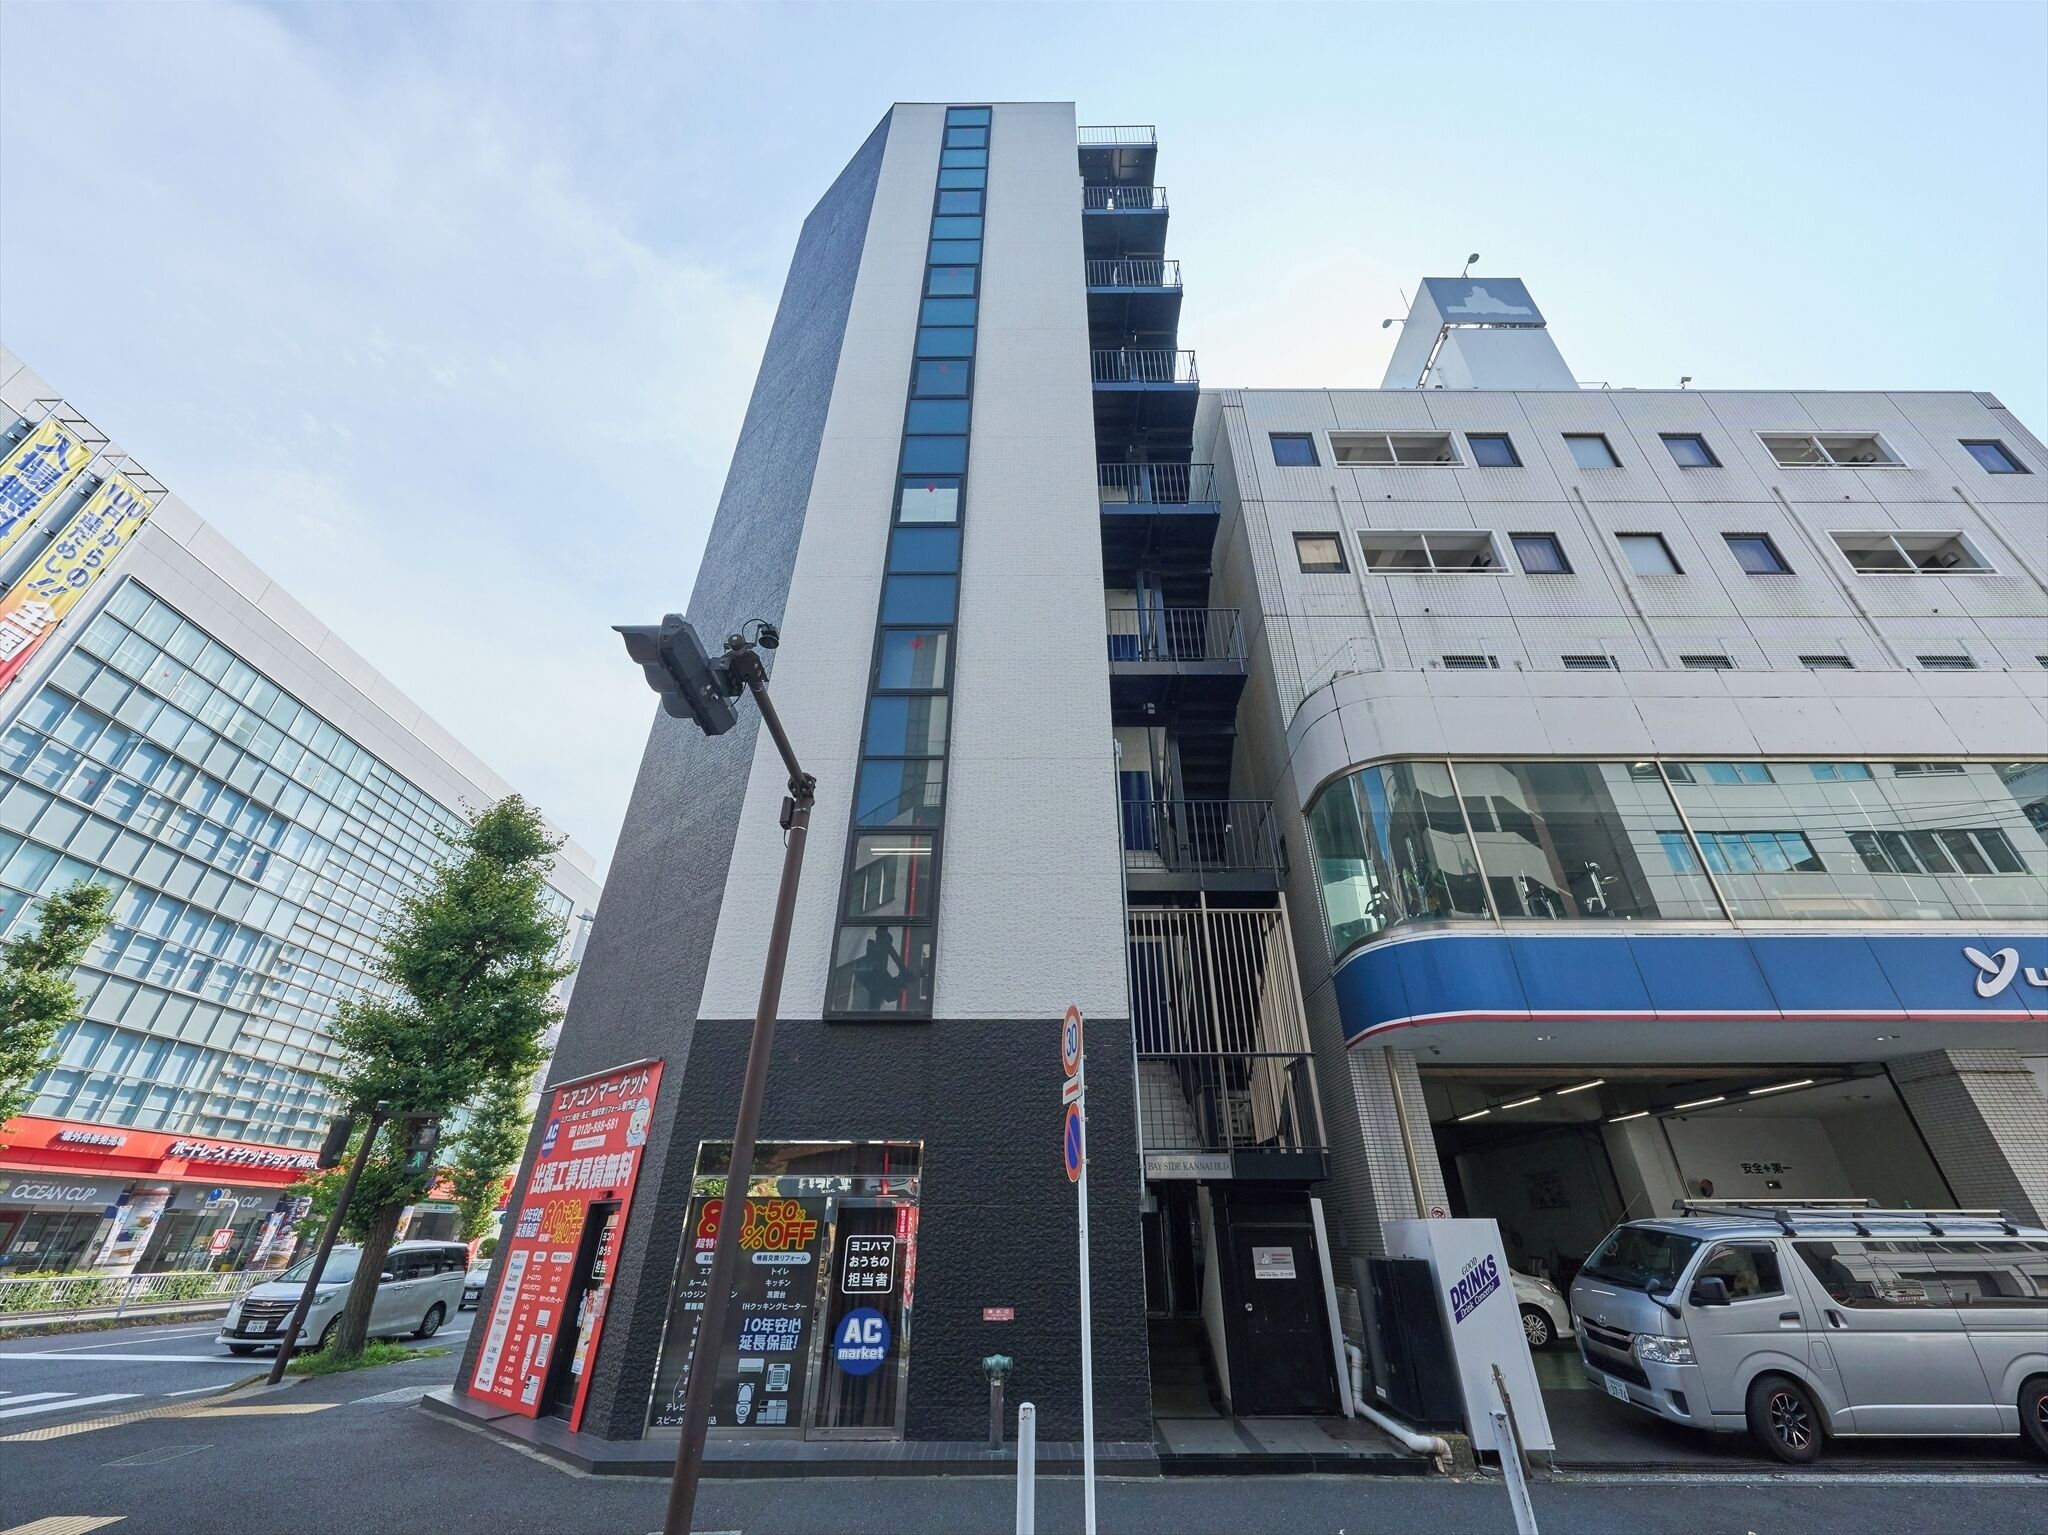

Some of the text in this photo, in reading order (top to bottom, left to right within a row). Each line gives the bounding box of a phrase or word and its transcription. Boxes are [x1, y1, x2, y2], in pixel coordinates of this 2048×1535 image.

[1067, 1023, 1077, 1056] 30
[558, 1070, 649, 1111] エアコンマーケット
[546, 1124, 559, 1141] AC
[529, 1149, 635, 1195] 出張工事見積無料
[1148, 1162, 1162, 1171] BAY
[1163, 1162, 1181, 1171] SIDE
[1183, 1162, 1213, 1171] KANNAI
[11, 1184, 98, 1201] OCEAN CUP
[241, 1197, 263, 1208] CUP
[851, 1241, 891, 1252] ヨコハマ
[849, 1256, 890, 1267] おうちの
[1461, 1256, 1477, 1275] GOOD
[765, 1279, 791, 1287] キッチン
[848, 1272, 888, 1287] 担当者
[1450, 1254, 1497, 1312] DRINKS
[742, 1303, 807, 1311] IHクッキングヒーター
[743, 1317, 801, 1333] 10年安心
[843, 1317, 883, 1344] AC
[738, 1334, 798, 1351] 延長保証!
[838, 1346, 884, 1360] market
